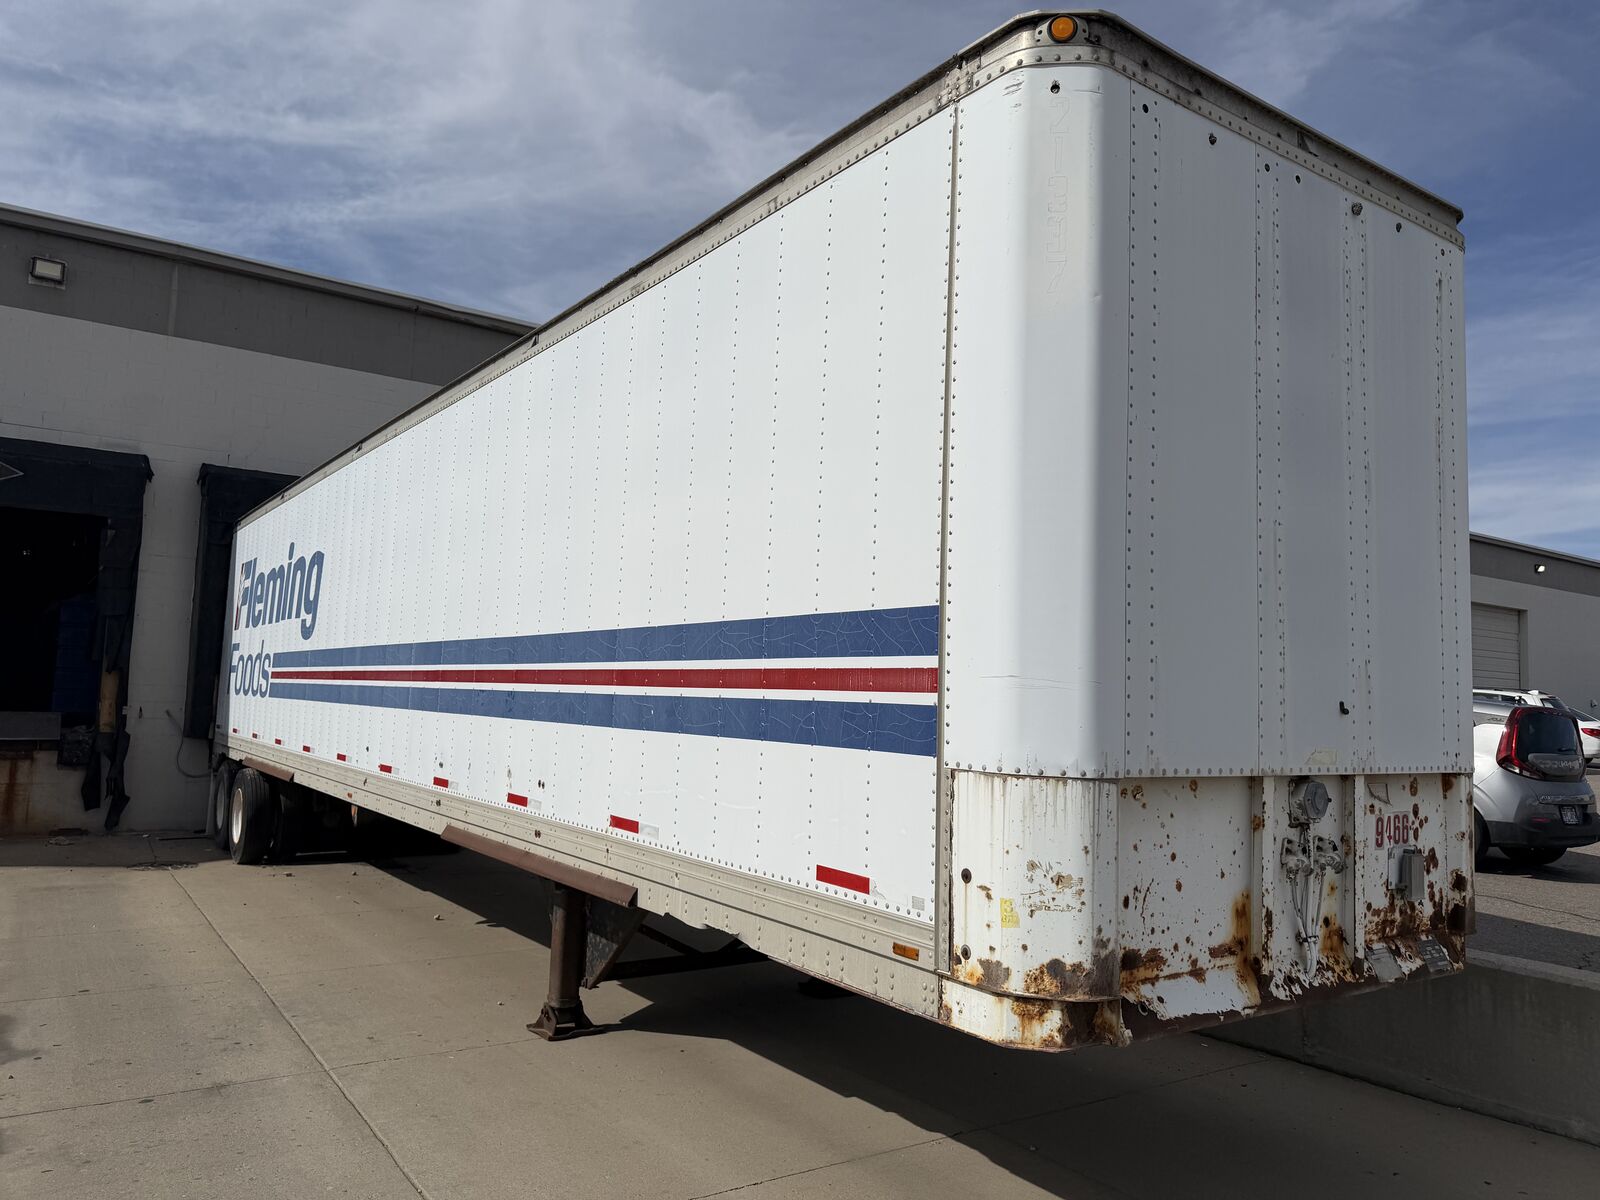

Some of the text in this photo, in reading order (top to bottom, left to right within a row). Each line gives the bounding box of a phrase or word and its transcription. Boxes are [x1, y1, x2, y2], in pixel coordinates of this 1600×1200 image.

[234, 542, 325, 640] Fleming
[227, 639, 271, 698] Foods
[1375, 814, 1409, 848] 9466
